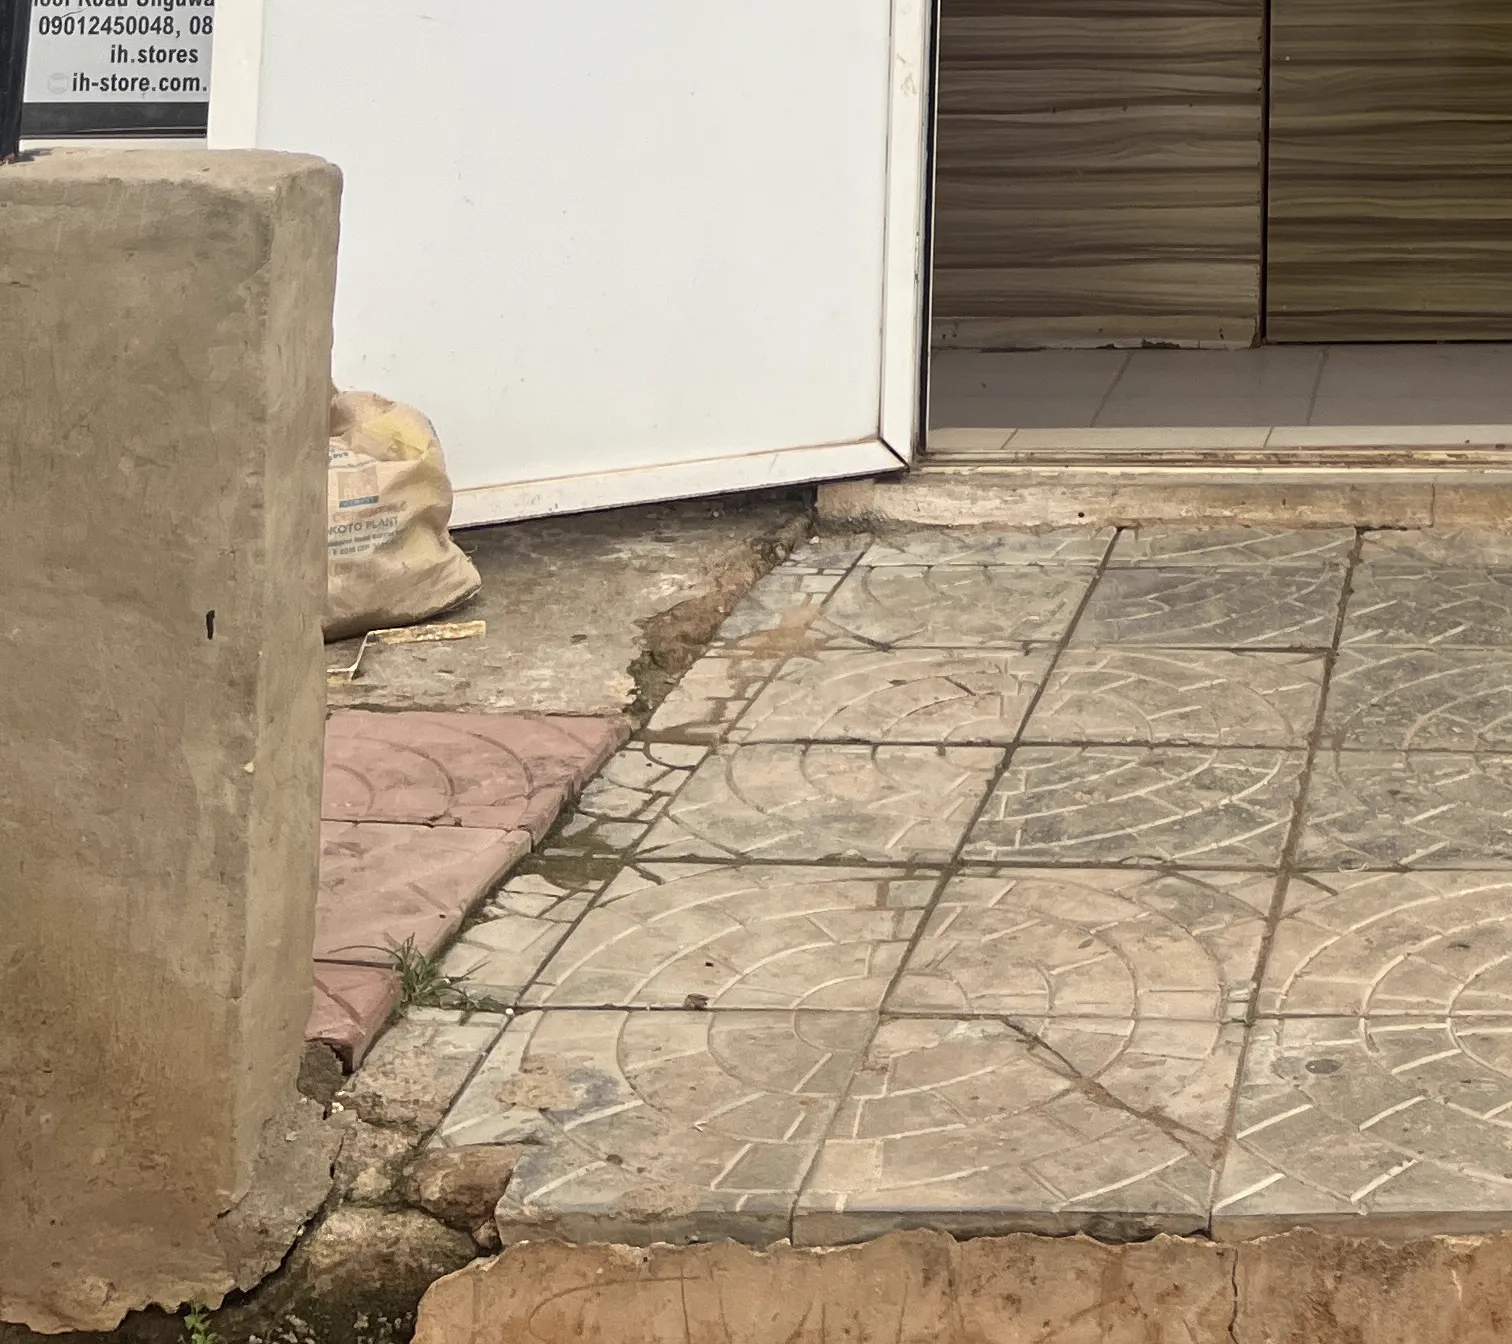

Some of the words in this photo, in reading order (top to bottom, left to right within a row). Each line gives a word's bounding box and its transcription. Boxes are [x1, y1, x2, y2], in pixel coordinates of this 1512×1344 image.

[38, 15, 181, 39] 09012450048,
[189, 15, 213, 35] 08
[110, 44, 199, 63] ih.stores
[71, 72, 207, 92] ih-store.com.
[329, 521, 363, 536] KOTO
